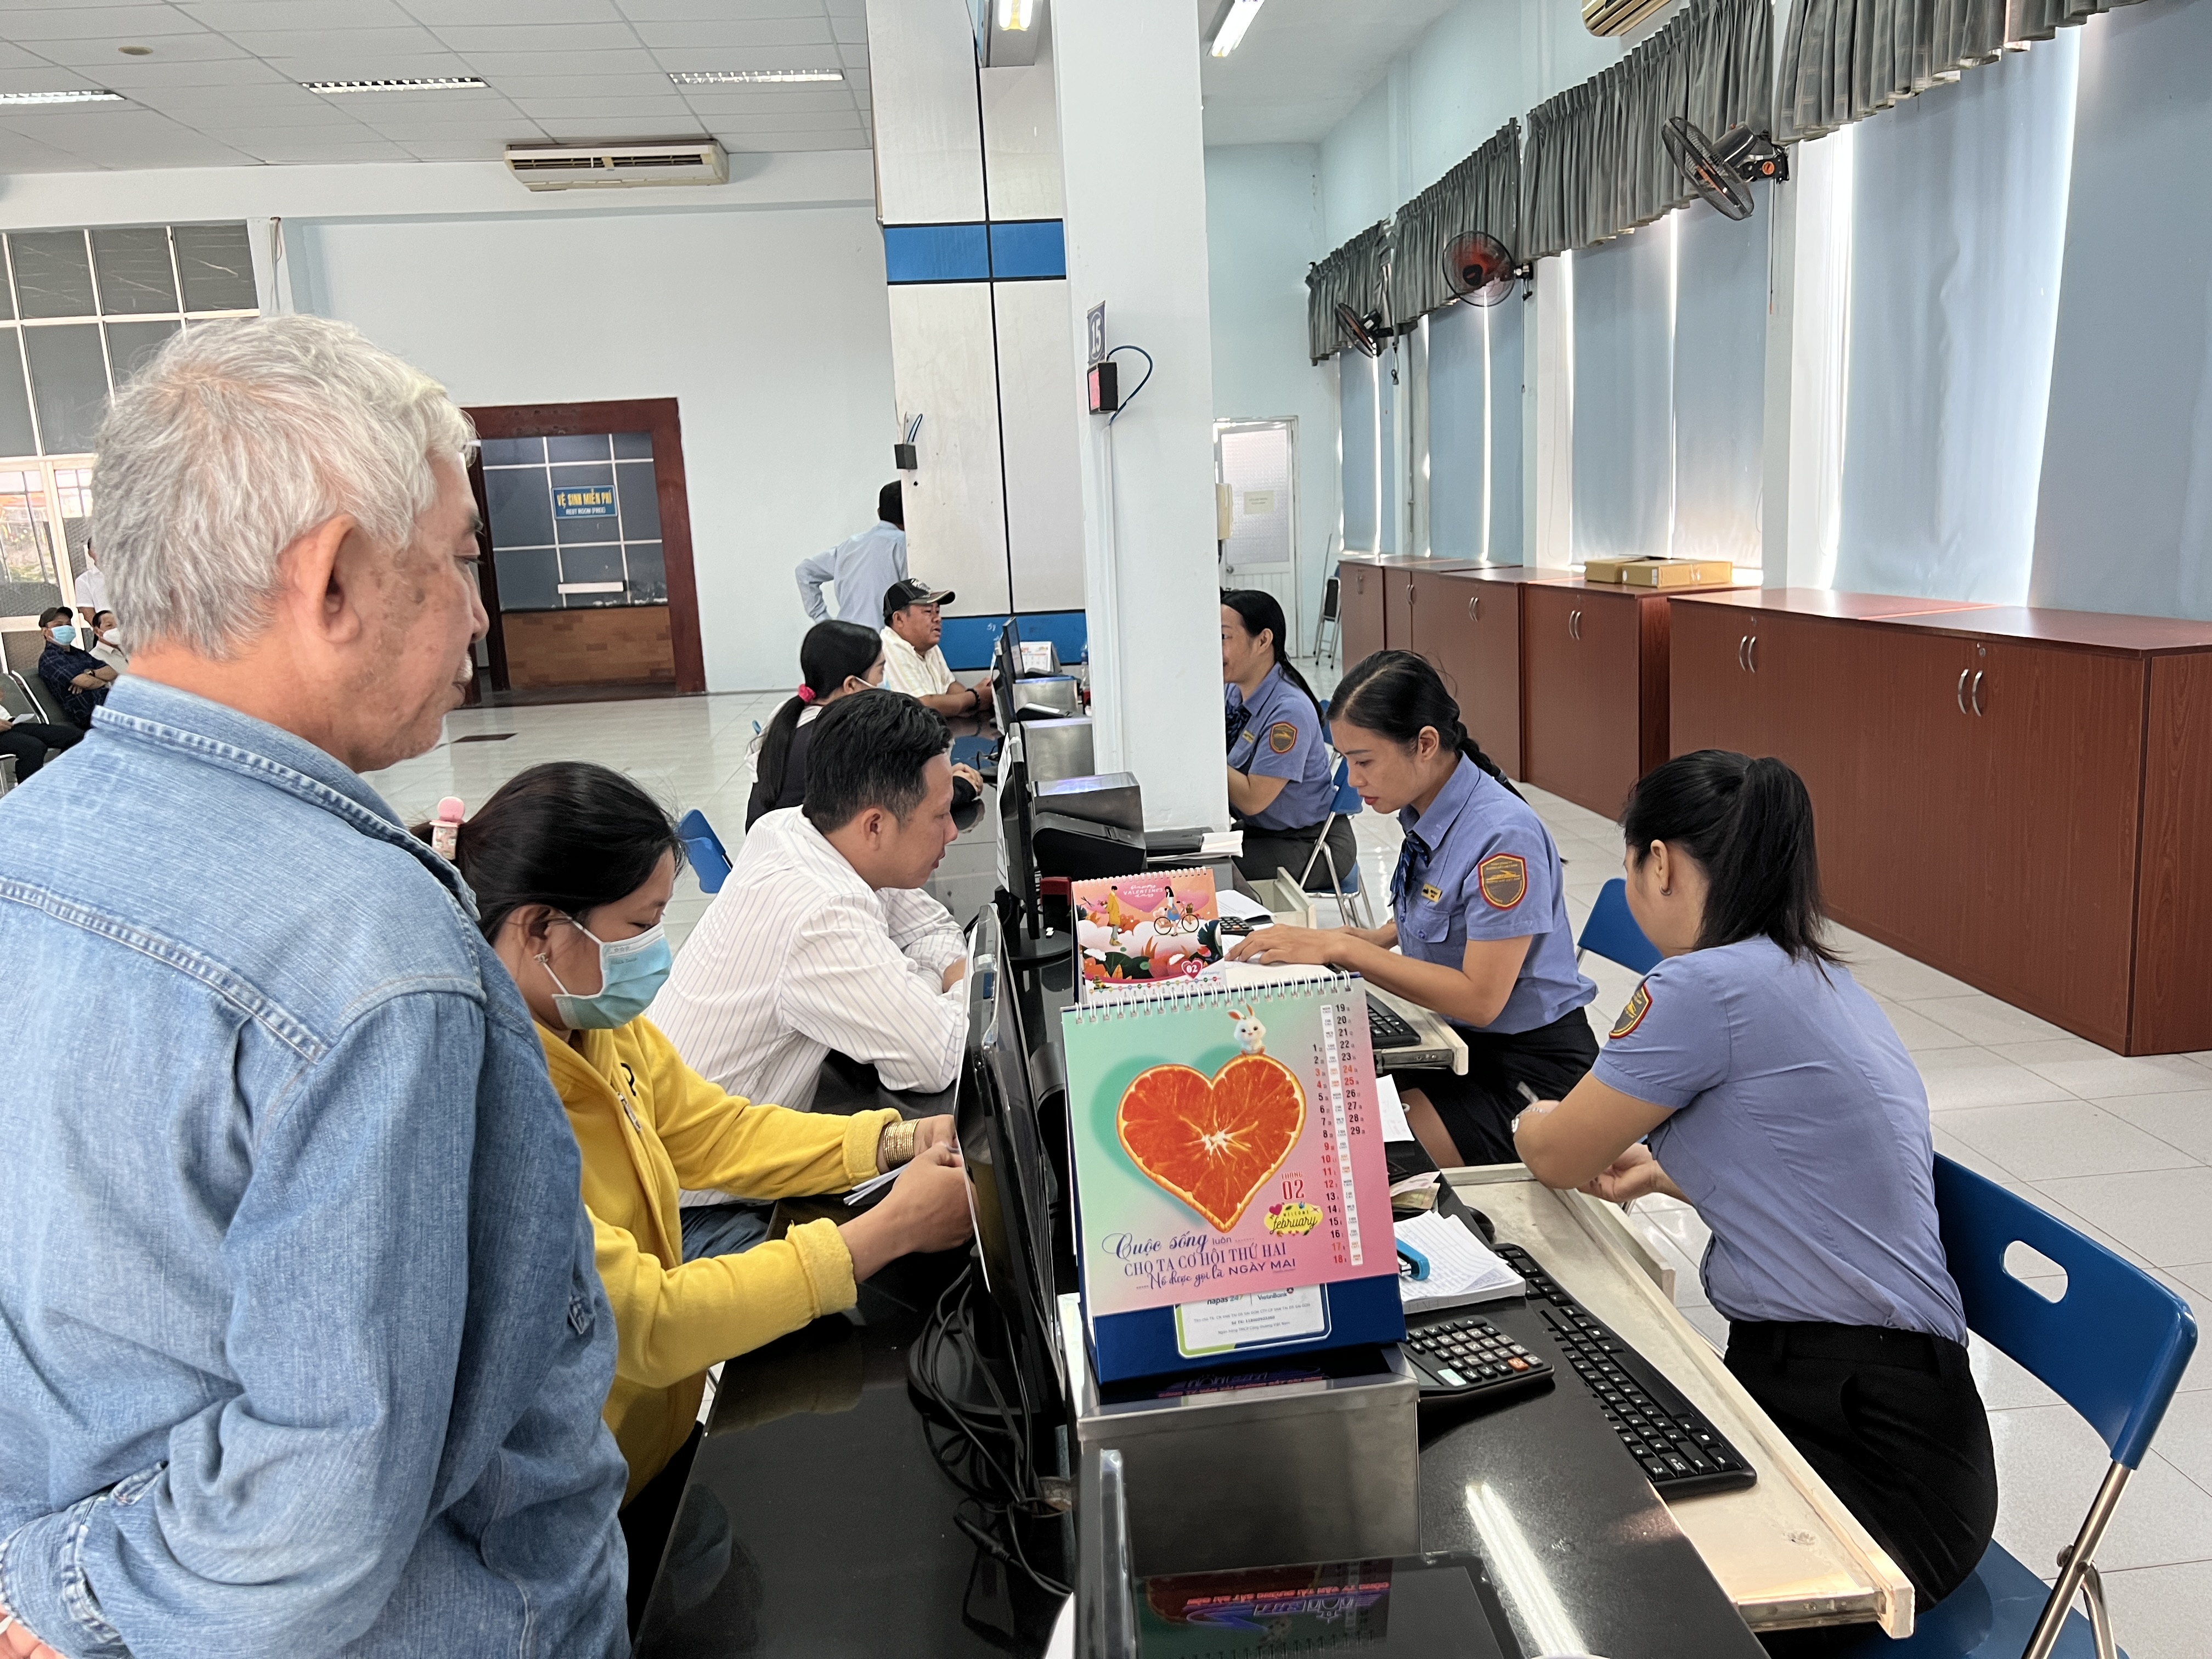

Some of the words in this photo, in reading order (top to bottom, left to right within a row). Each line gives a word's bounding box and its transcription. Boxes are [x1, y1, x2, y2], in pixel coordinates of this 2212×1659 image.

[1091, 317, 1102, 354] 15
[1186, 964, 1198, 973] 02
[1335, 1003, 1345, 1012] 19
[1337, 1015, 1347, 1024] 20
[1339, 1028, 1348, 1036] 21
[1312, 1043, 1317, 1052] 1
[1340, 1040, 1350, 1049] 22
[1313, 1056, 1319, 1064] 2
[1341, 1052, 1351, 1061] 23
[1315, 1068, 1320, 1076] 3
[1342, 1065, 1353, 1074] 24
[1317, 1080, 1322, 1088] 4
[1344, 1077, 1354, 1086] 25
[1318, 1093, 1323, 1101] 5
[1346, 1089, 1356, 1098] 26
[1319, 1105, 1325, 1113] 6
[1347, 1101, 1357, 1110] 27
[1321, 1117, 1325, 1126] 7
[1349, 1114, 1359, 1122] 28
[1323, 1130, 1328, 1138] 8
[1350, 1126, 1361, 1135] 29
[1324, 1142, 1329, 1150] 9
[1321, 1154, 1331, 1163] 10
[1323, 1167, 1331, 1176] 11
[1324, 1180, 1334, 1188] 12
[1282, 1179, 1305, 1200] 02
[1326, 1192, 1335, 1201] 13
[1327, 1204, 1337, 1214] 14
[1269, 1216, 1318, 1235] february
[1329, 1217, 1339, 1226] 15
[1330, 1229, 1340, 1239] 16
[1102, 1232, 1162, 1262] Cuộc
[1169, 1231, 1208, 1254] sống
[1212, 1236, 1232, 1245] luôn
[1331, 1242, 1341, 1251] 17
[1156, 1257, 1175, 1272] TA
[1178, 1252, 1197, 1269] CƠ
[1228, 1242, 1257, 1262] THỨ
[1262, 1242, 1286, 1257] HAI
[1334, 1254, 1343, 1263] 18
[1211, 1264, 1224, 1279] là
[1228, 1261, 1266, 1276] NGÀY
[1271, 1258, 1295, 1270] MAI
[1257, 1291, 1288, 1300] VietinBank
[1207, 1296, 1228, 1306] napas
